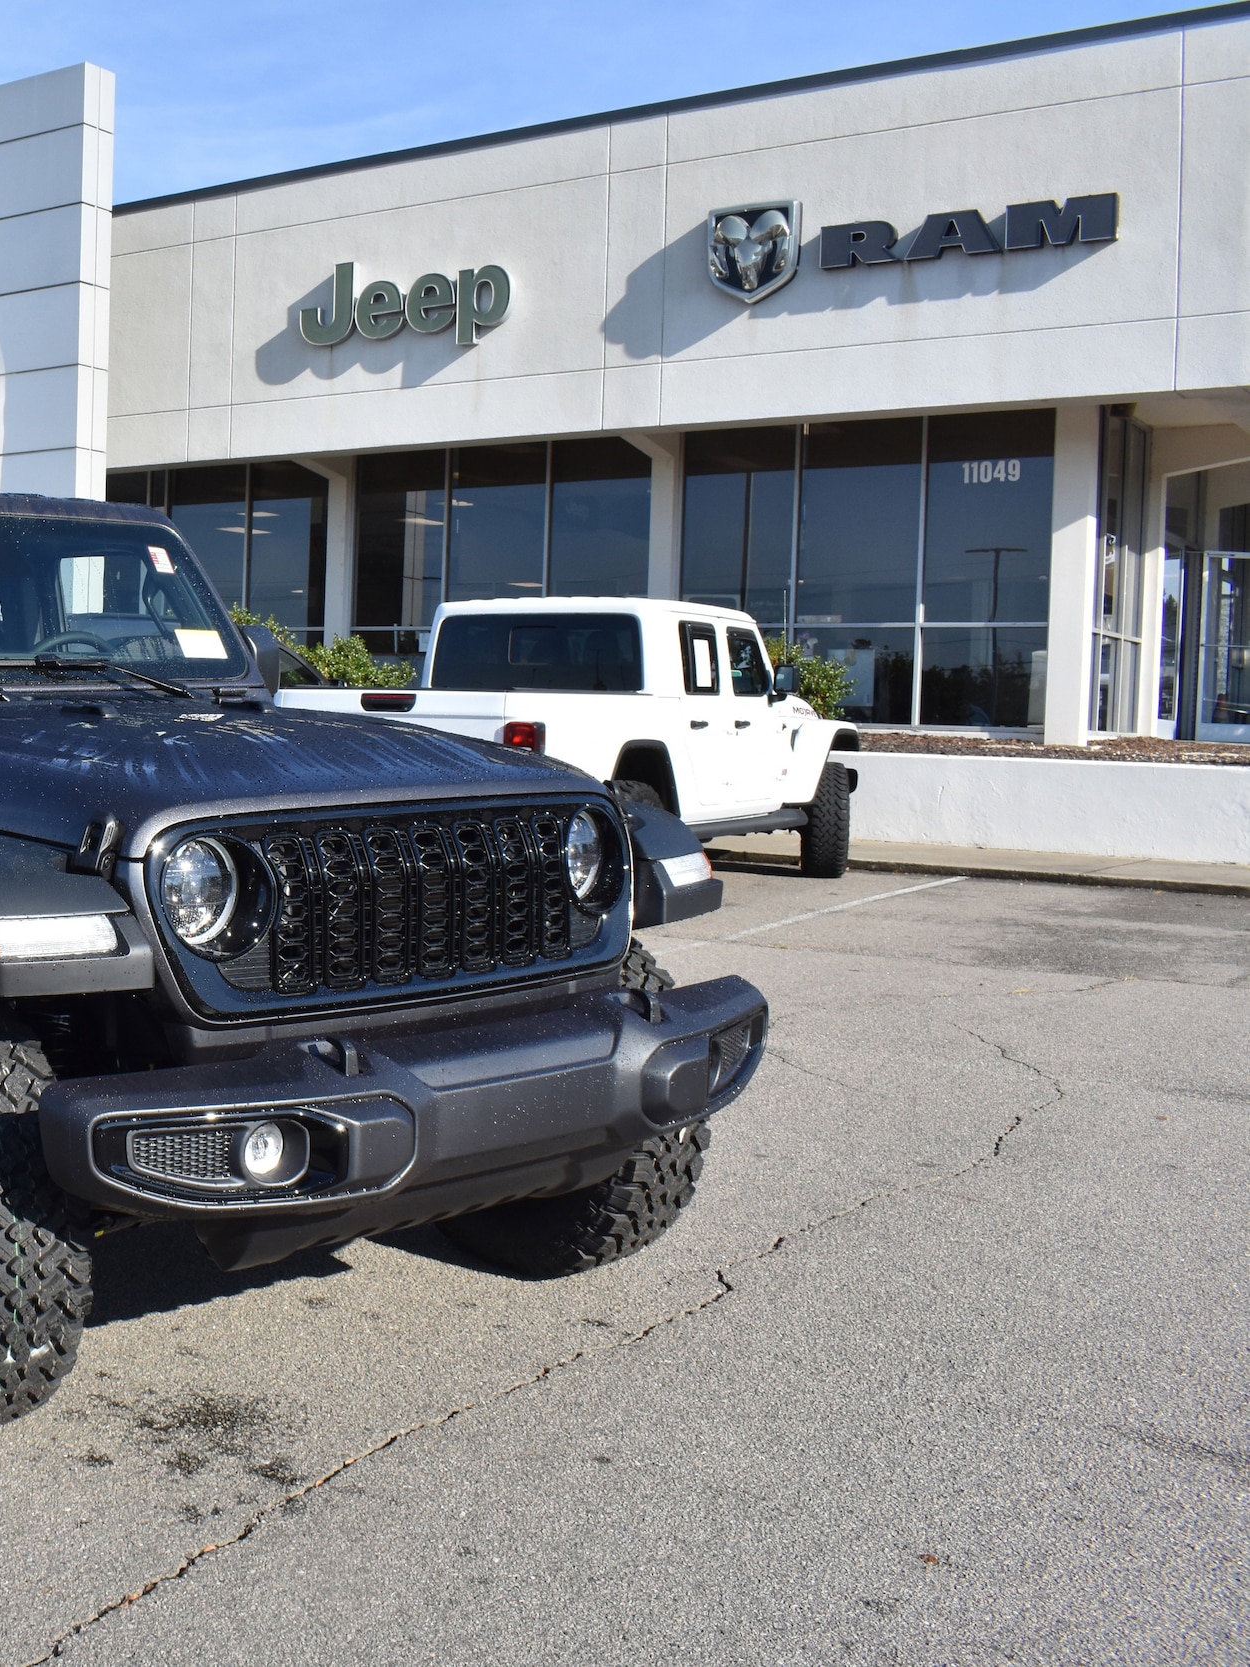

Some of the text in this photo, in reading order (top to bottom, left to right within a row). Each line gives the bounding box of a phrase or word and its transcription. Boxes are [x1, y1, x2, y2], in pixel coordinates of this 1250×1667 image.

[819, 192, 1120, 270] RAM
[299, 261, 516, 346] Jeep
[962, 459, 1021, 484] 11049
